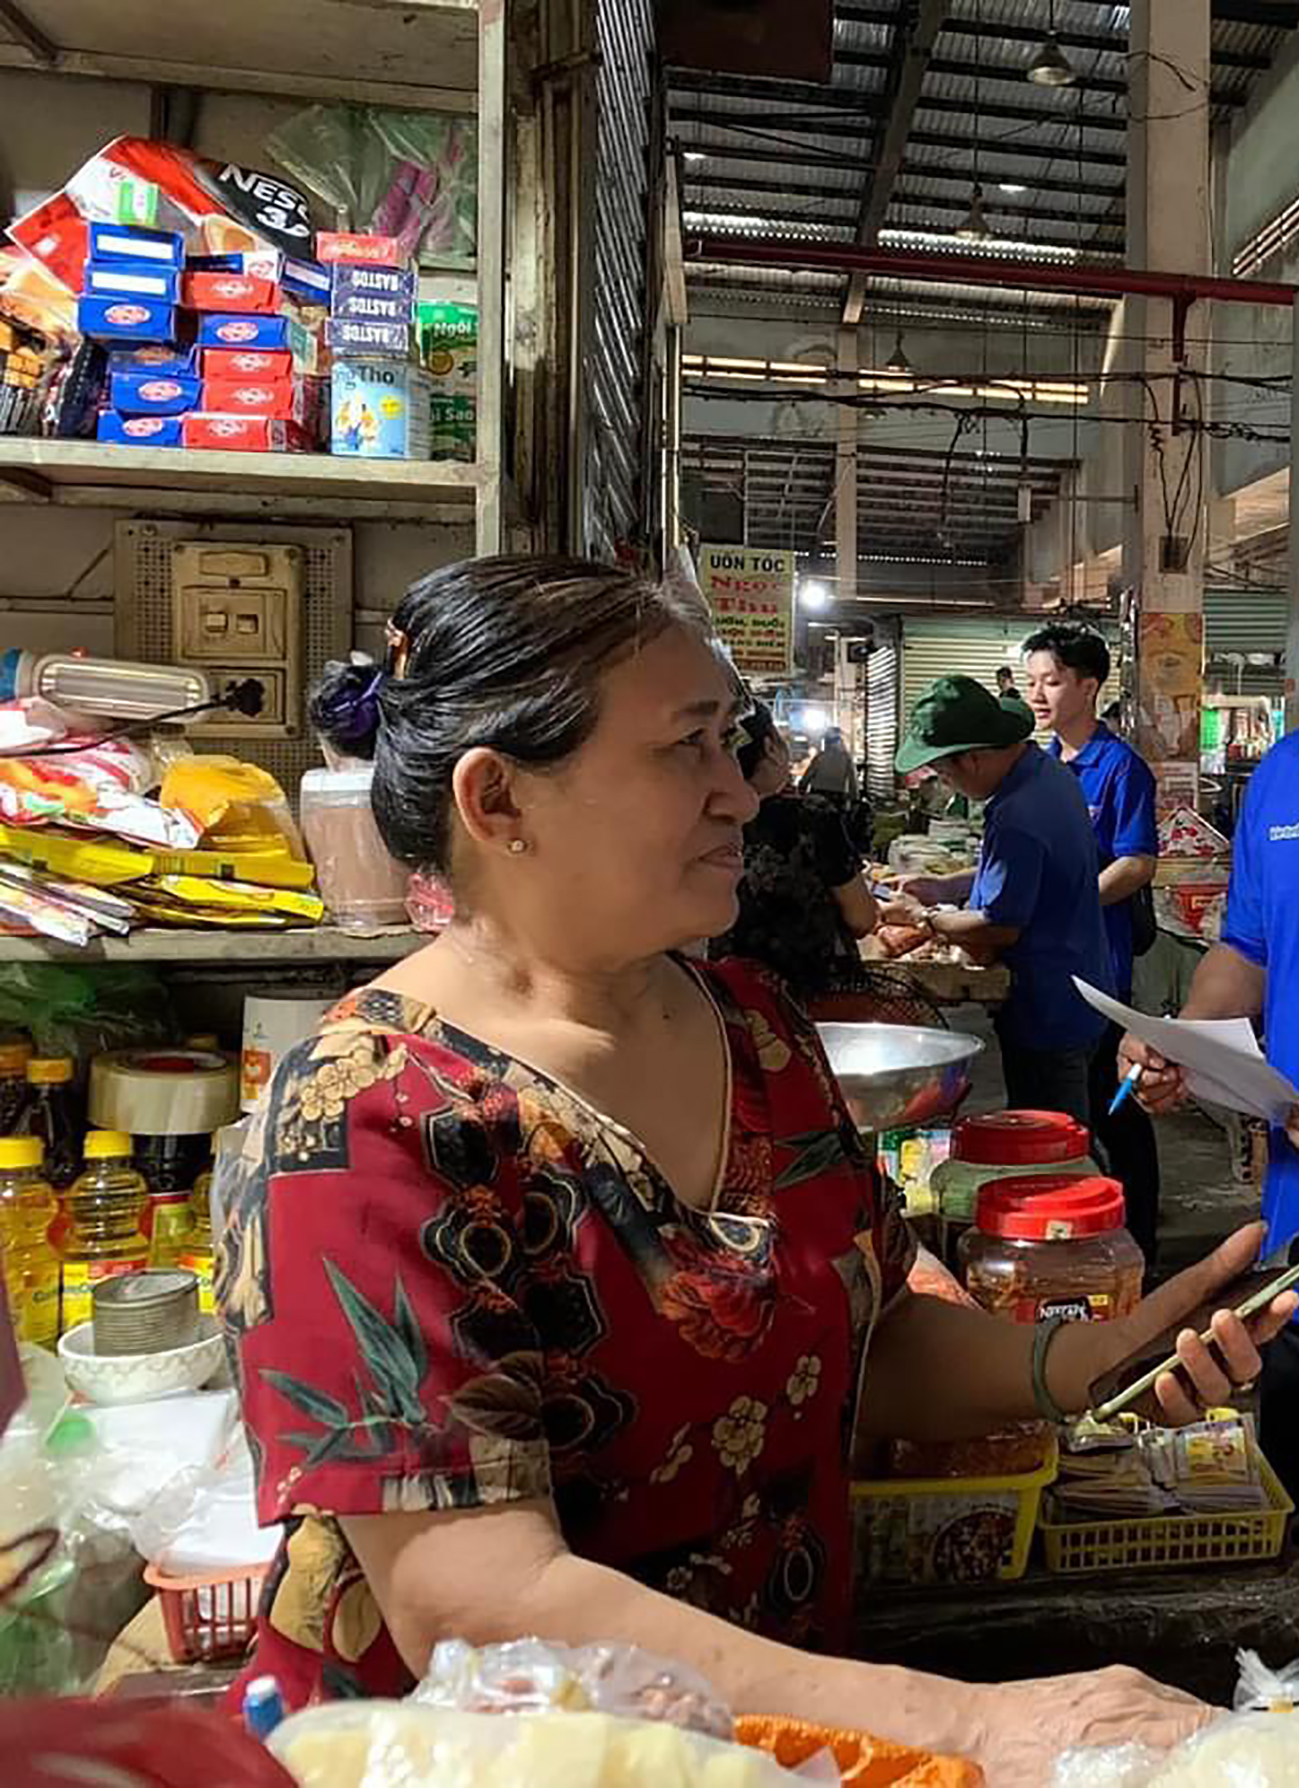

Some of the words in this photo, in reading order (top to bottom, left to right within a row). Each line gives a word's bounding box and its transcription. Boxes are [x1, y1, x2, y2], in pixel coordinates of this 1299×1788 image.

[351, 270, 399, 291] BASTOS
[348, 296, 396, 317] BASTOS
[342, 324, 389, 343] BASTOS
